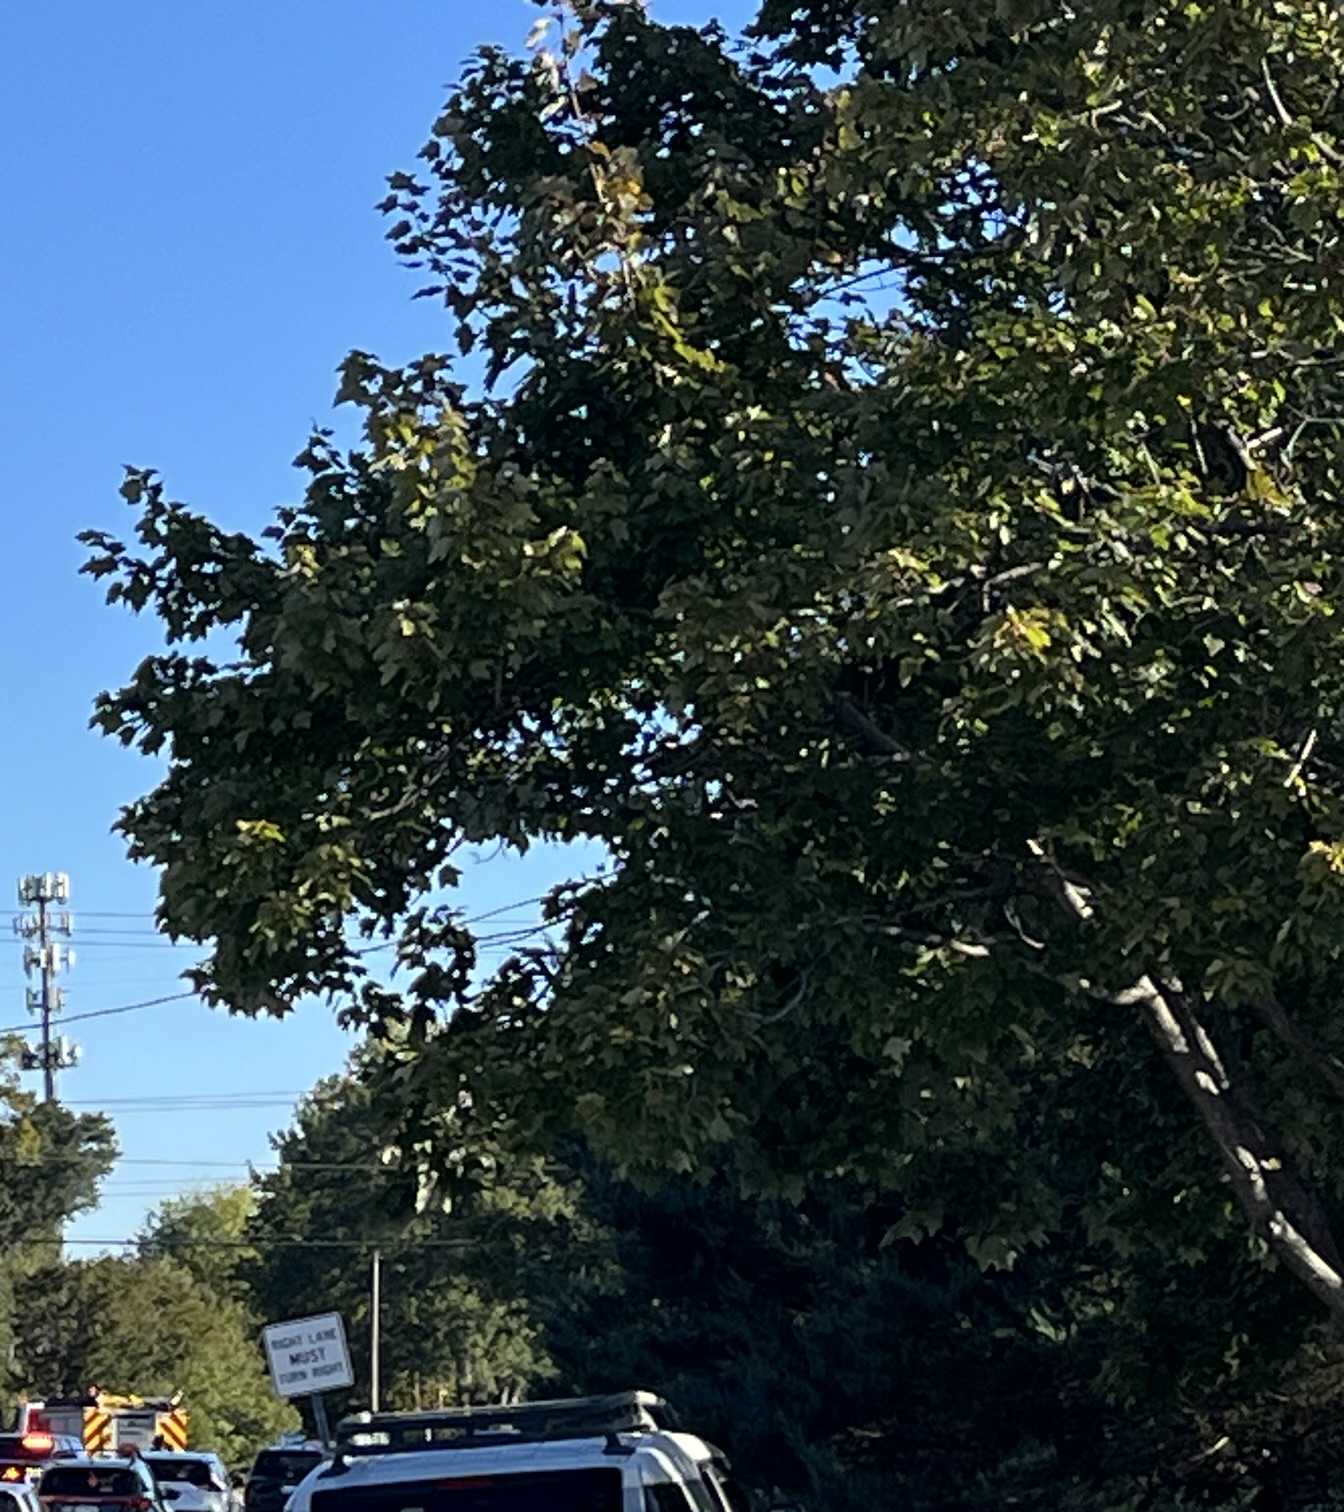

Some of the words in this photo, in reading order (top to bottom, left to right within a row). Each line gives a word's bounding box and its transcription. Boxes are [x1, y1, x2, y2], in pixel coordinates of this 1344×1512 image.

[272, 1335, 303, 1350] RIGHT
[308, 1328, 336, 1344] LANE
[289, 1347, 325, 1365] MUST
[278, 1371, 307, 1384] TURN
[313, 1362, 343, 1378] RIGHT
